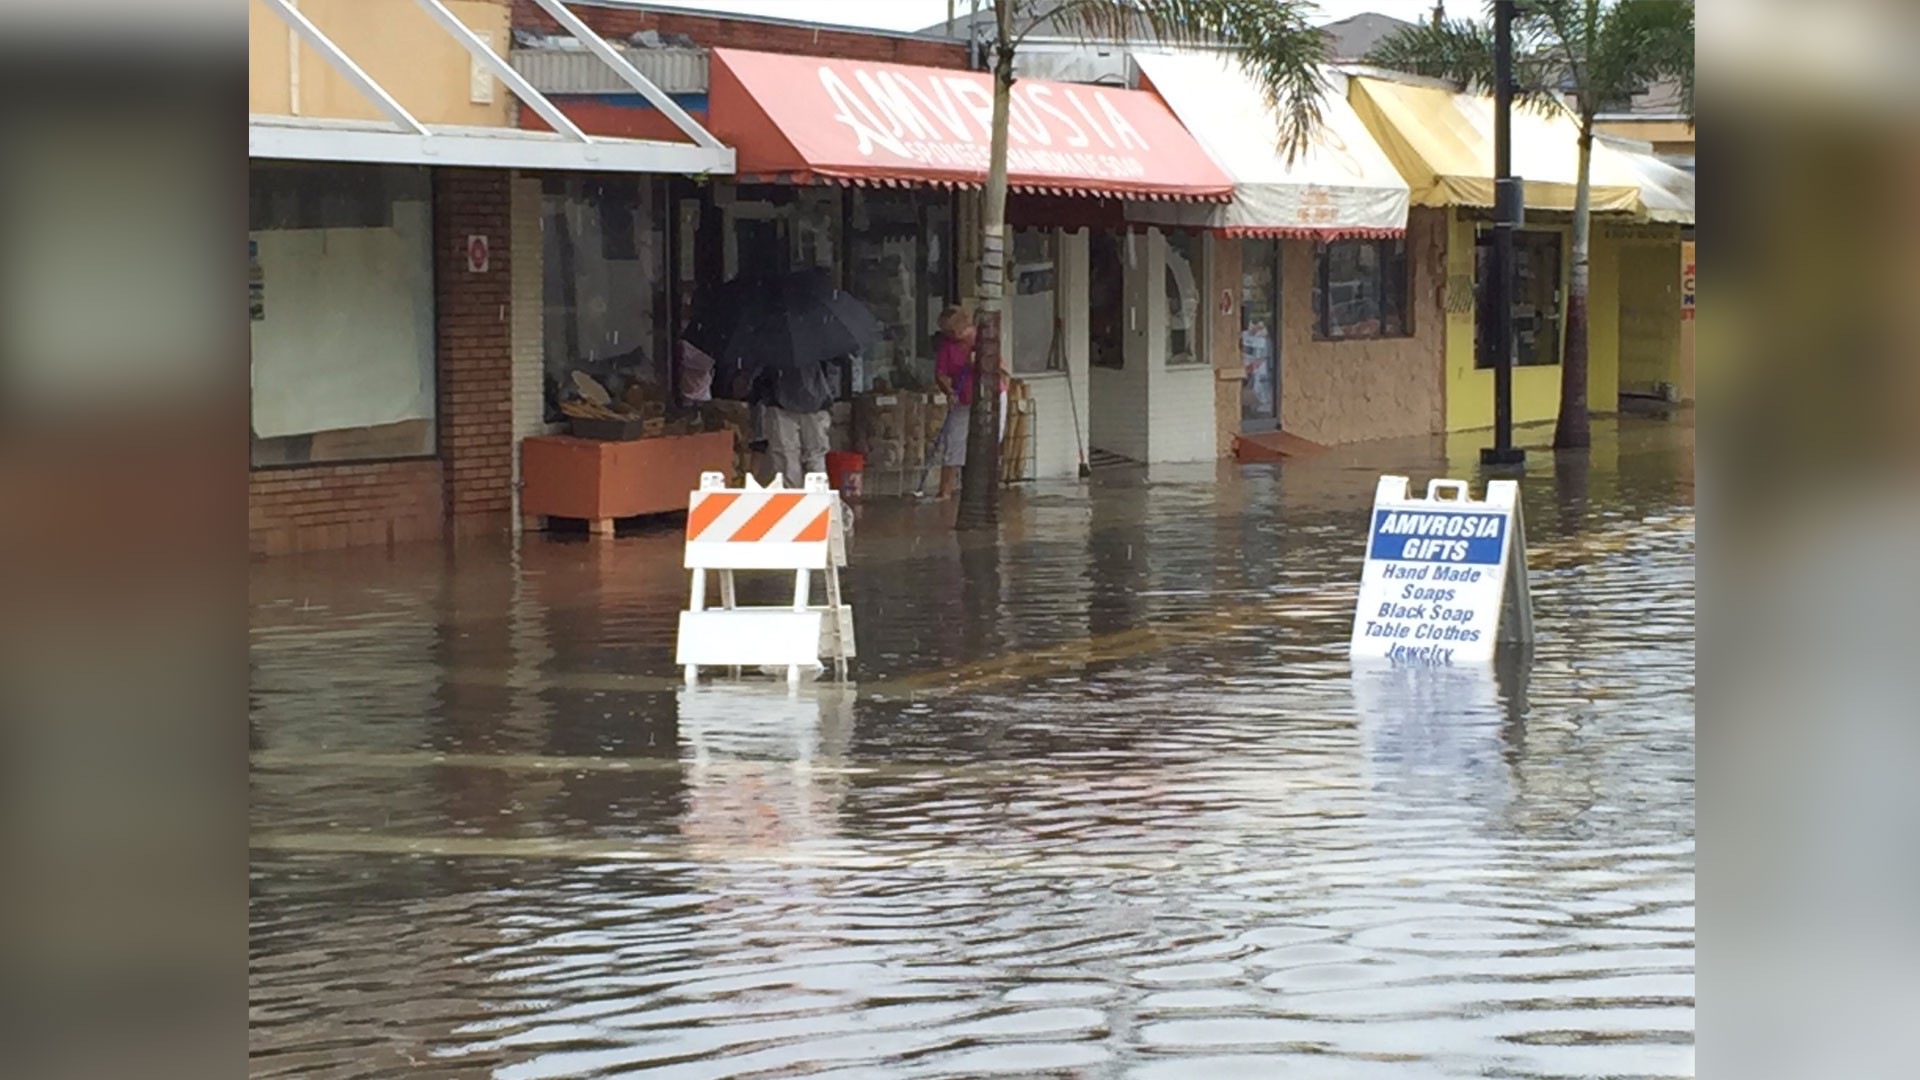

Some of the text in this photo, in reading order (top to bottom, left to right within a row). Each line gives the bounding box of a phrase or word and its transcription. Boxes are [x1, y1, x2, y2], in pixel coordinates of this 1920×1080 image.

[1379, 514, 1500, 538] AMVROSIA
[1402, 538, 1469, 561] GIFTS
[1382, 563, 1481, 583] Hand Made
[1401, 583, 1456, 603] Soaps
[1377, 602, 1474, 625] Black Soap
[1364, 621, 1481, 642] Table Clothes
